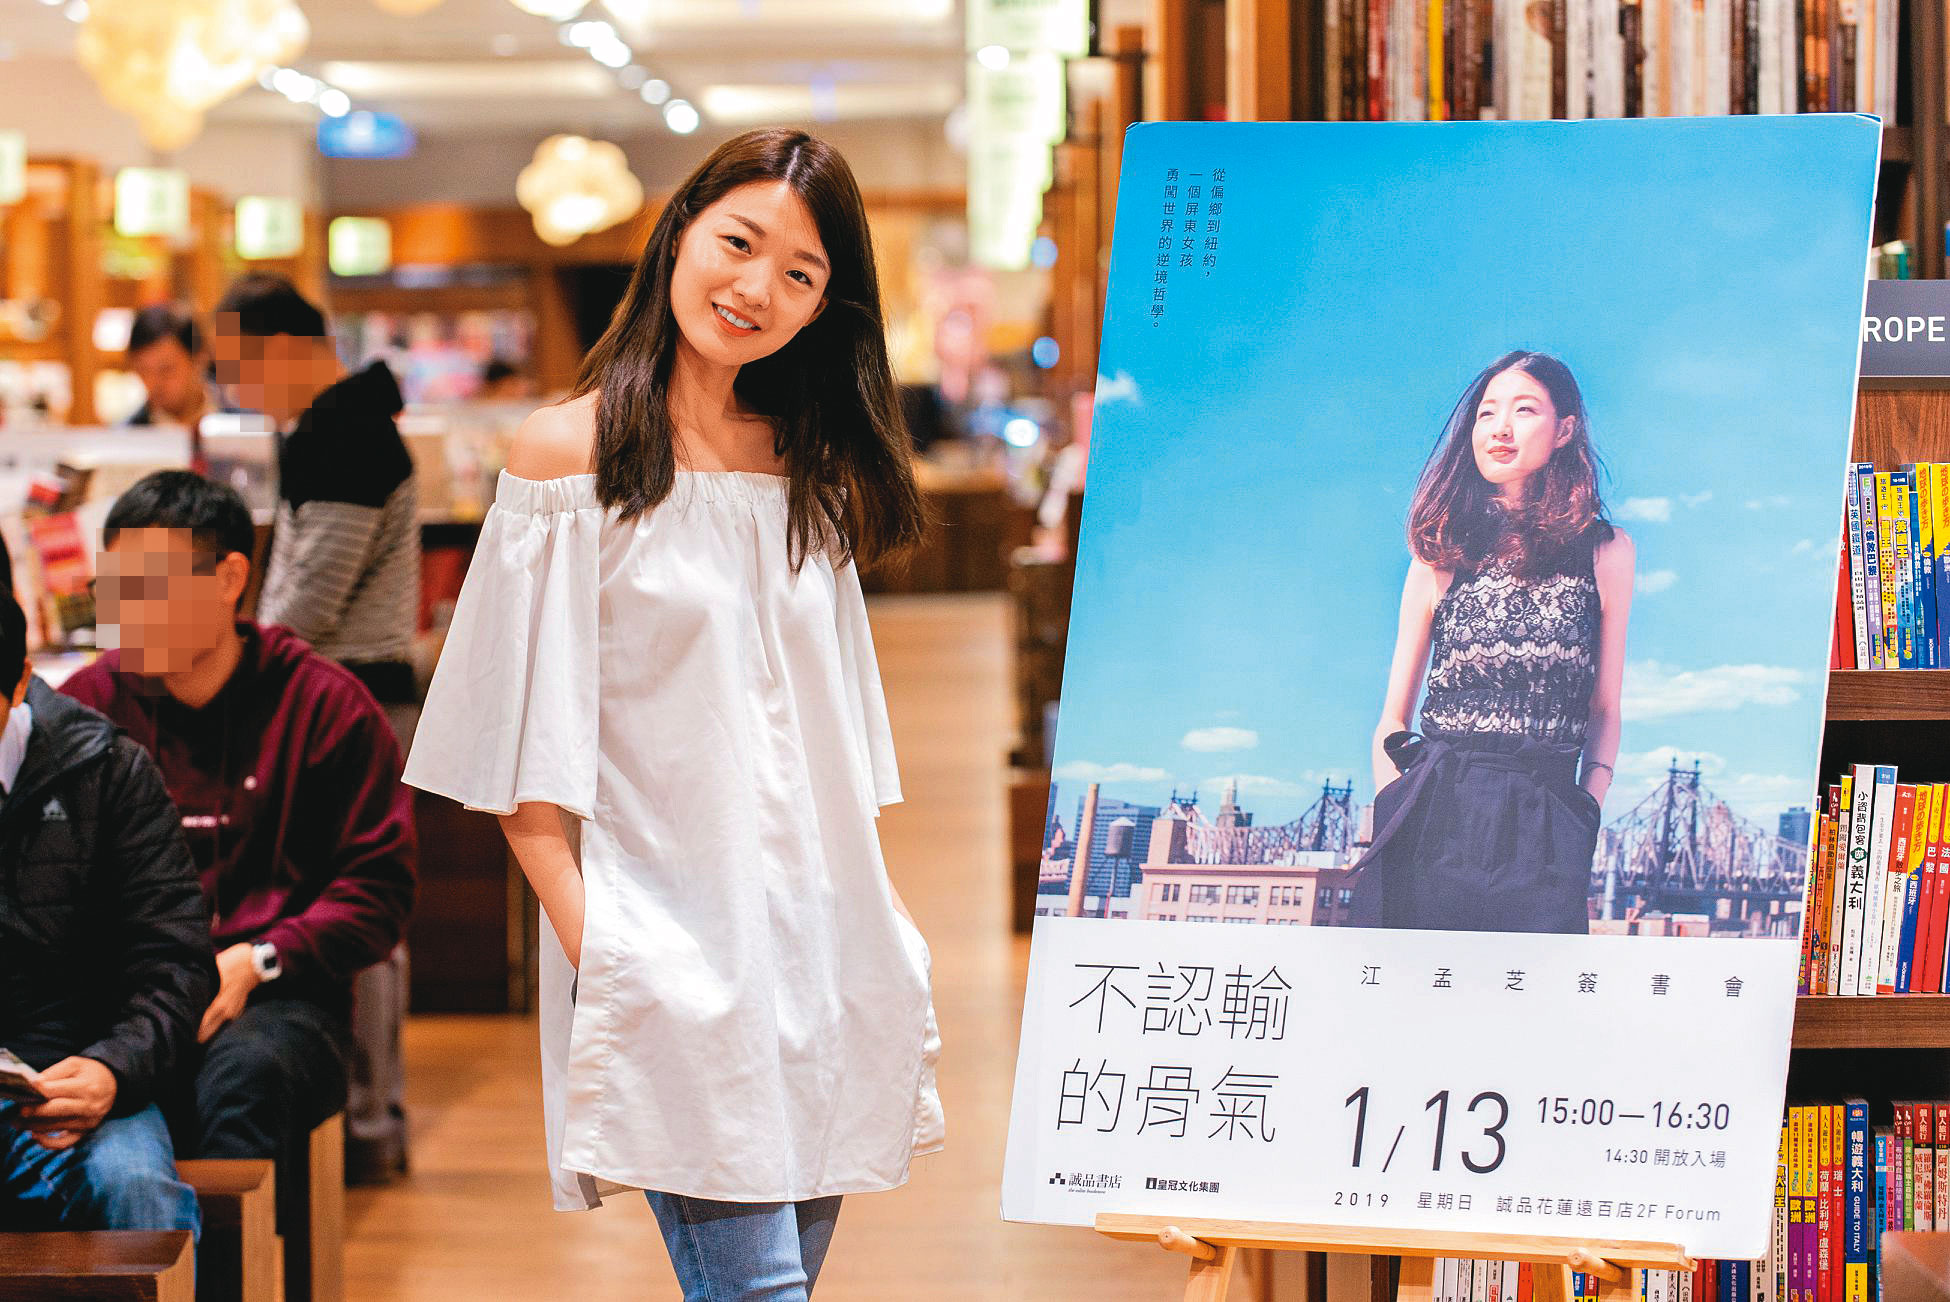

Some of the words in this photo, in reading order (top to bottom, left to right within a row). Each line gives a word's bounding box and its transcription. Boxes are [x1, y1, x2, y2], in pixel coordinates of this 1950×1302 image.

[1179, 173, 1203, 268] 一個屏東女孩
[1202, 168, 1226, 278] 從偏鄉到紐約，
[1150, 168, 1179, 328] 勇闖世界的逆境哲學。
[1848, 865, 1866, 909] 義大利
[1360, 964, 1745, 999] 江孟芝簽書會
[1068, 961, 1293, 1040] 不認輸
[1057, 1058, 1280, 1143] 的骨氣
[1344, 1086, 1510, 1175] 1/13
[1605, 1149, 1649, 1164] 14:30
[1653, 1149, 1727, 1169] 開放入場
[1851, 1131, 1864, 1192] 暢遊義大利
[1068, 1172, 1122, 1189] 誠品書店
[1157, 1179, 1220, 1194] 皇冠文化集團
[1833, 1169, 1843, 1197] 瑞士
[1334, 1191, 1391, 1209] 2019
[1416, 1192, 1473, 1211] 星期日
[1664, 1205, 1722, 1221] Forum
[1853, 1195, 1861, 1218] GUIDE
[1853, 1220, 1861, 1231] TO
[1853, 1233, 1861, 1253] ITALY
